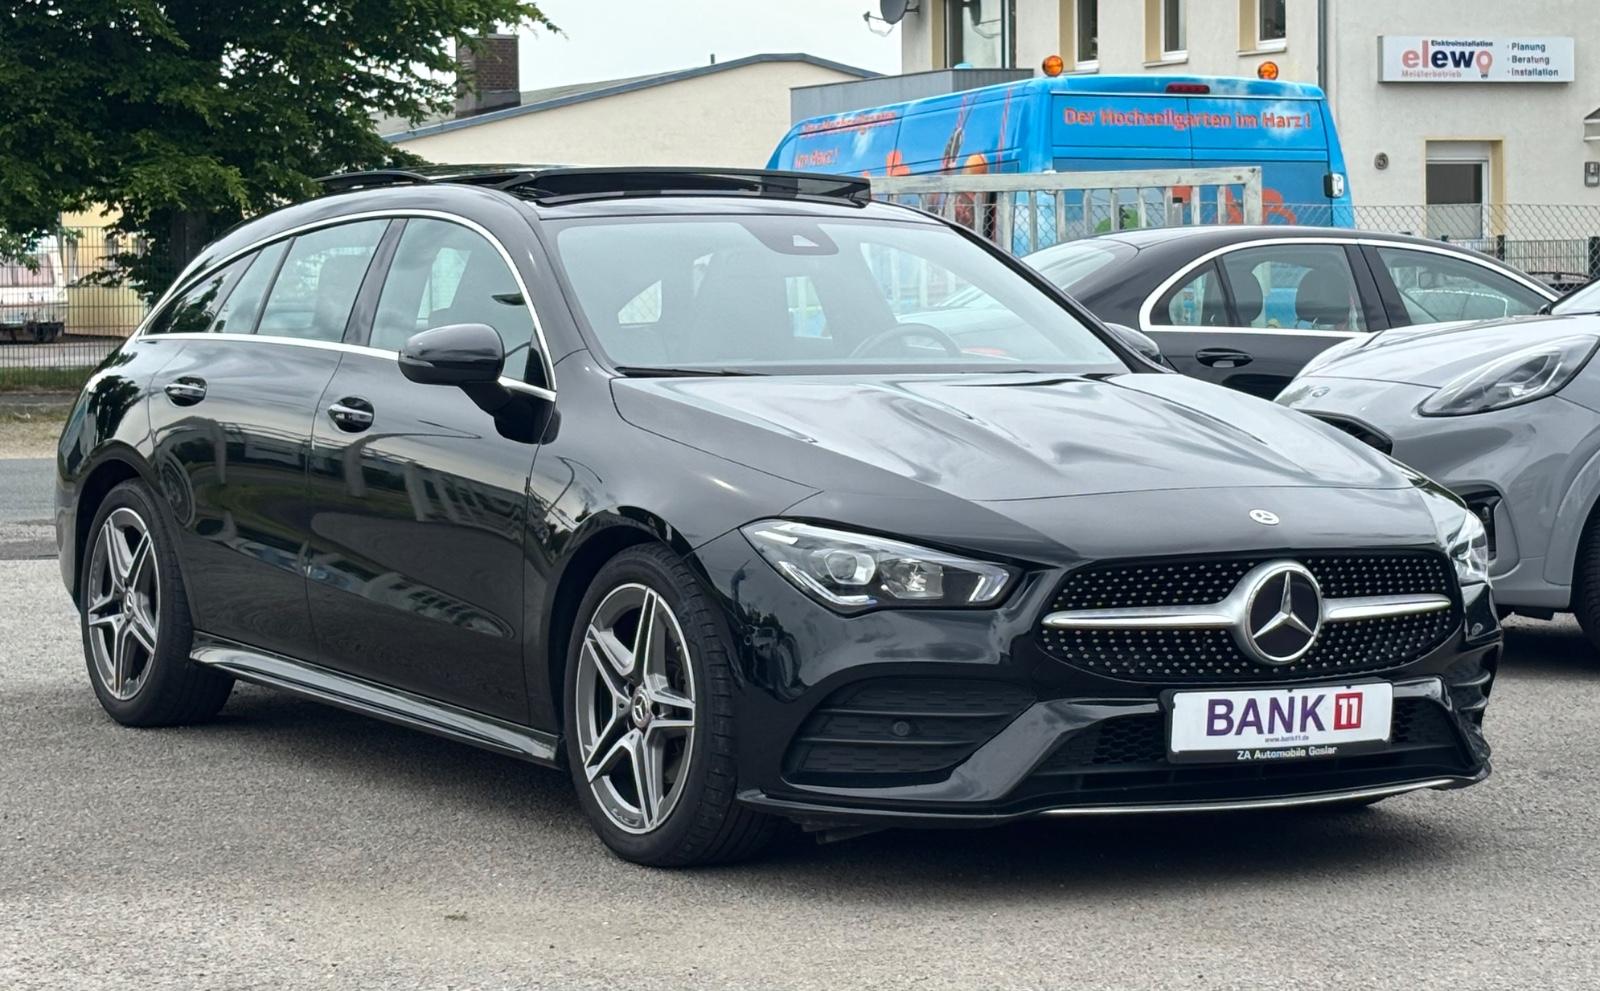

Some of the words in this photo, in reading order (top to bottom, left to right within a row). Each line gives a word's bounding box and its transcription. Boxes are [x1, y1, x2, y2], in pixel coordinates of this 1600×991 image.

[1511, 42, 1546, 53] Planung
[1511, 55, 1550, 66] Beratung
[1511, 67, 1559, 77] Installation
[1064, 107, 1096, 125] Der
[1100, 107, 1232, 131] Hochseilgarten
[1235, 112, 1258, 128] im
[1206, 694, 1326, 736] BANK
[1338, 696, 1360, 726] 11
[1236, 750, 1252, 760] ZA
[1253, 747, 1306, 760] Automobile
